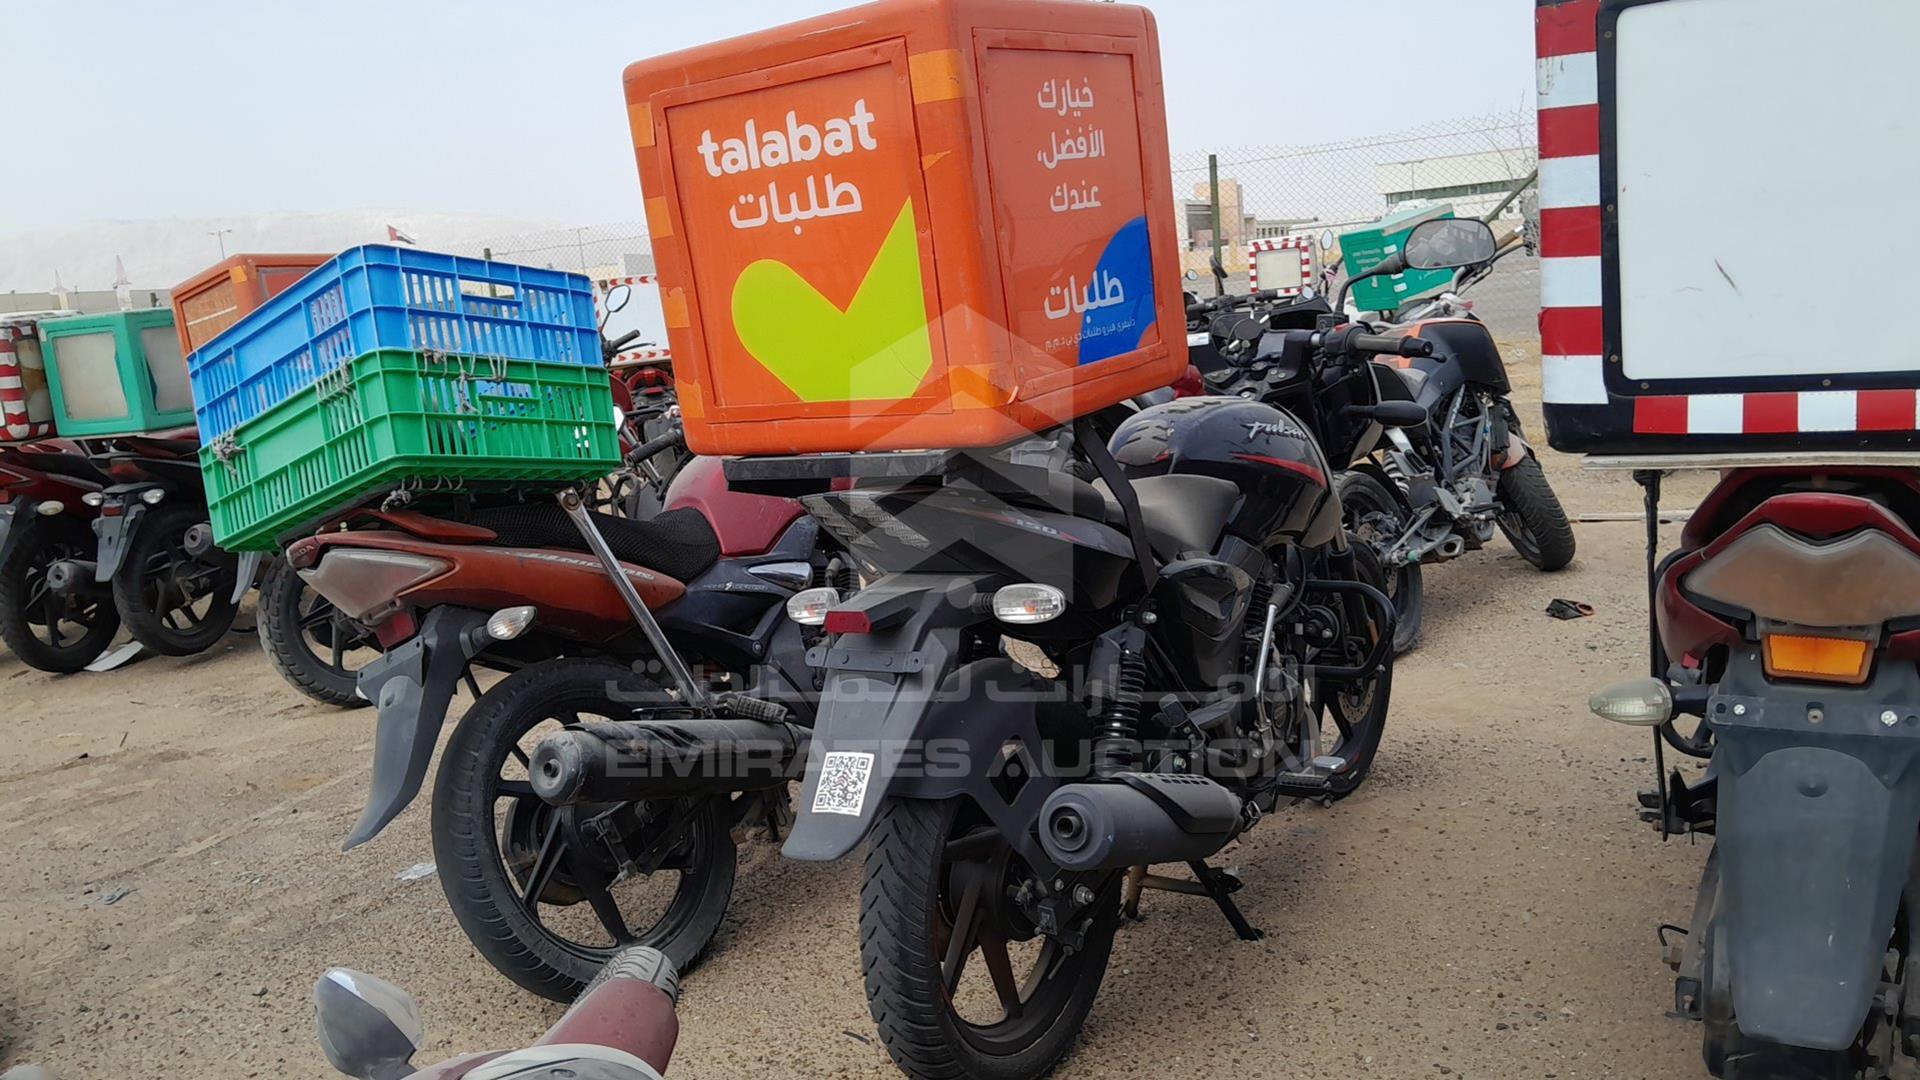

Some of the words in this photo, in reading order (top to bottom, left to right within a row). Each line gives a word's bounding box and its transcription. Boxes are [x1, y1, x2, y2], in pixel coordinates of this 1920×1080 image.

[1038, 77, 1094, 117] خيارك
[697, 98, 878, 177] talabat
[729, 173, 864, 235] طلبات
[1049, 179, 1102, 213] عندك
[1043, 269, 1125, 324] طلبات
